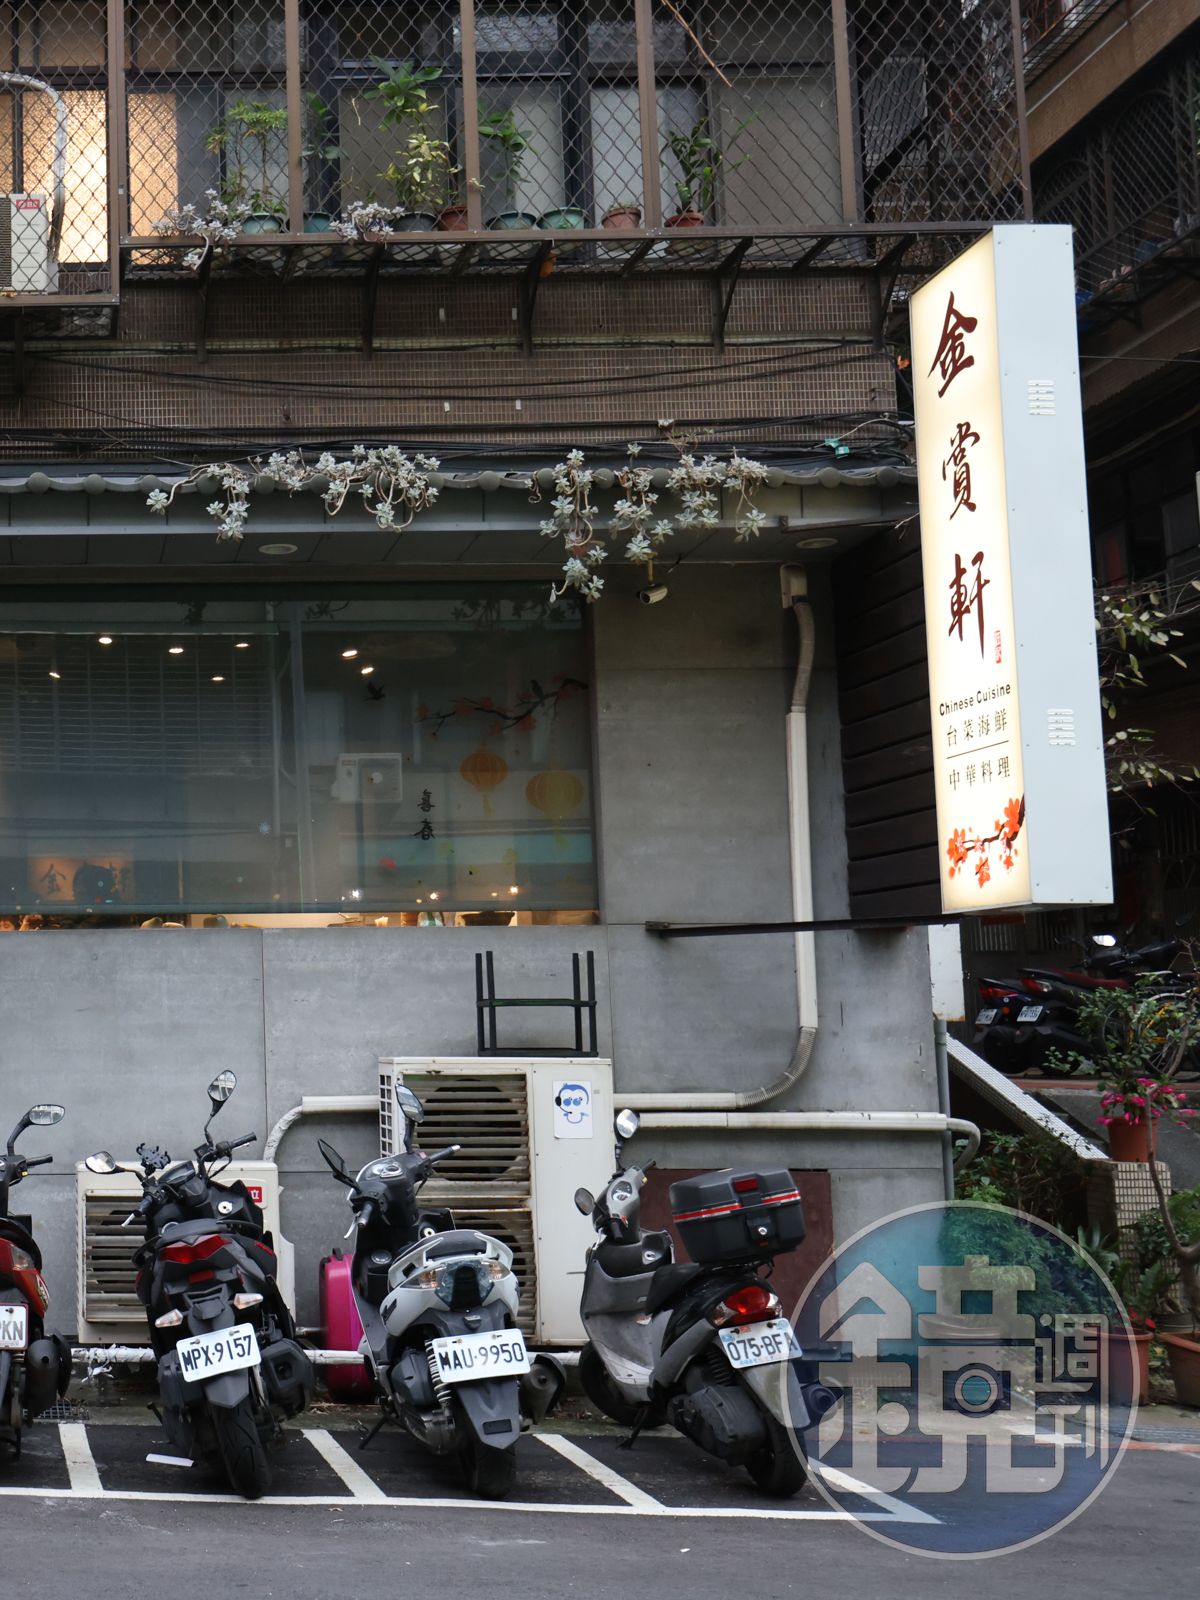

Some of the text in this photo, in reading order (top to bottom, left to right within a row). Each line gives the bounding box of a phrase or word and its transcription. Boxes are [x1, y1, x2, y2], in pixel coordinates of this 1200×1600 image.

[928, 291, 990, 660] 金賞軒
[939, 683, 1011, 717] Chinese Cuisine
[947, 708, 1007, 747] 台菜海鮮
[949, 756, 1010, 790] 中華料理
